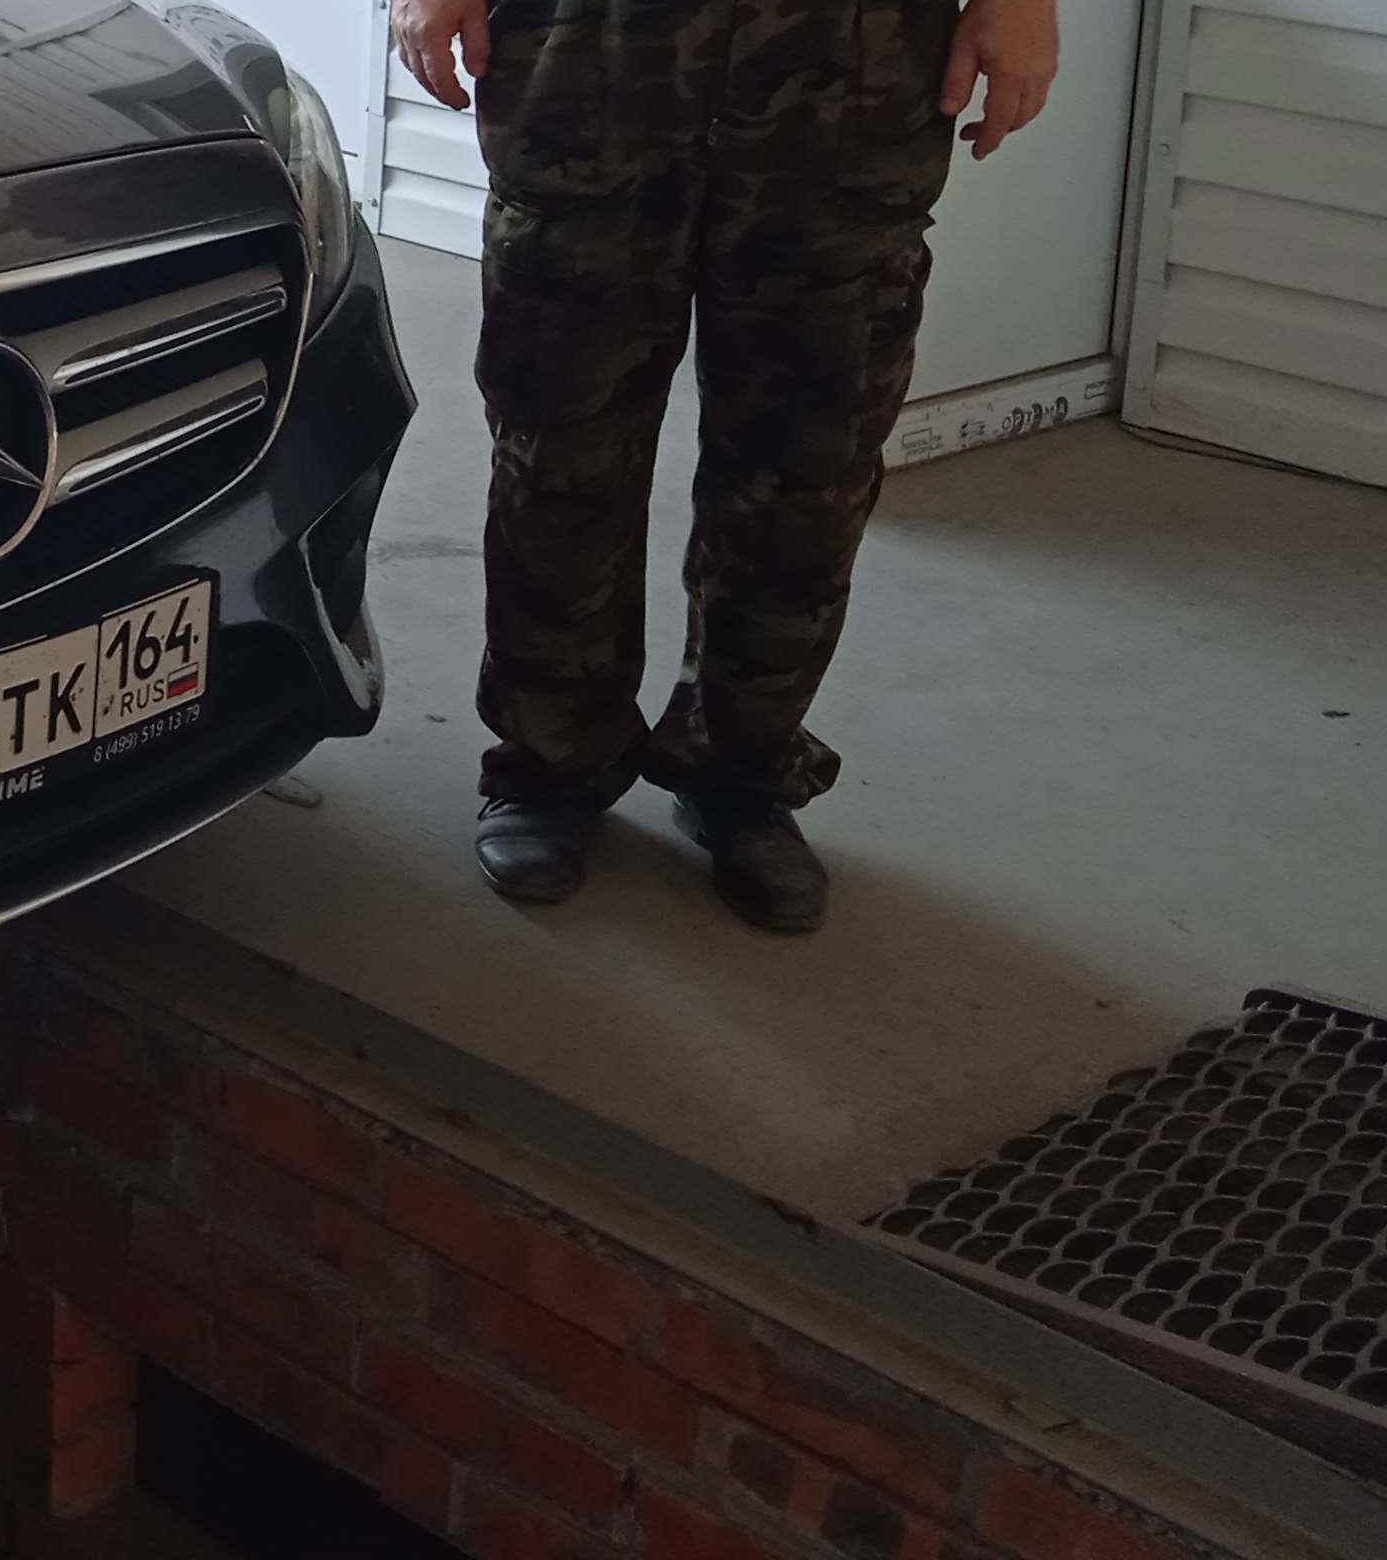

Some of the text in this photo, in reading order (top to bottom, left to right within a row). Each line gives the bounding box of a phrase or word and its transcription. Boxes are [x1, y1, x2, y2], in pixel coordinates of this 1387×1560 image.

[105, 596, 192, 690] 164
[120, 679, 165, 717] RUS
[141, 719, 164, 743] 519
[169, 711, 182, 731] 13
